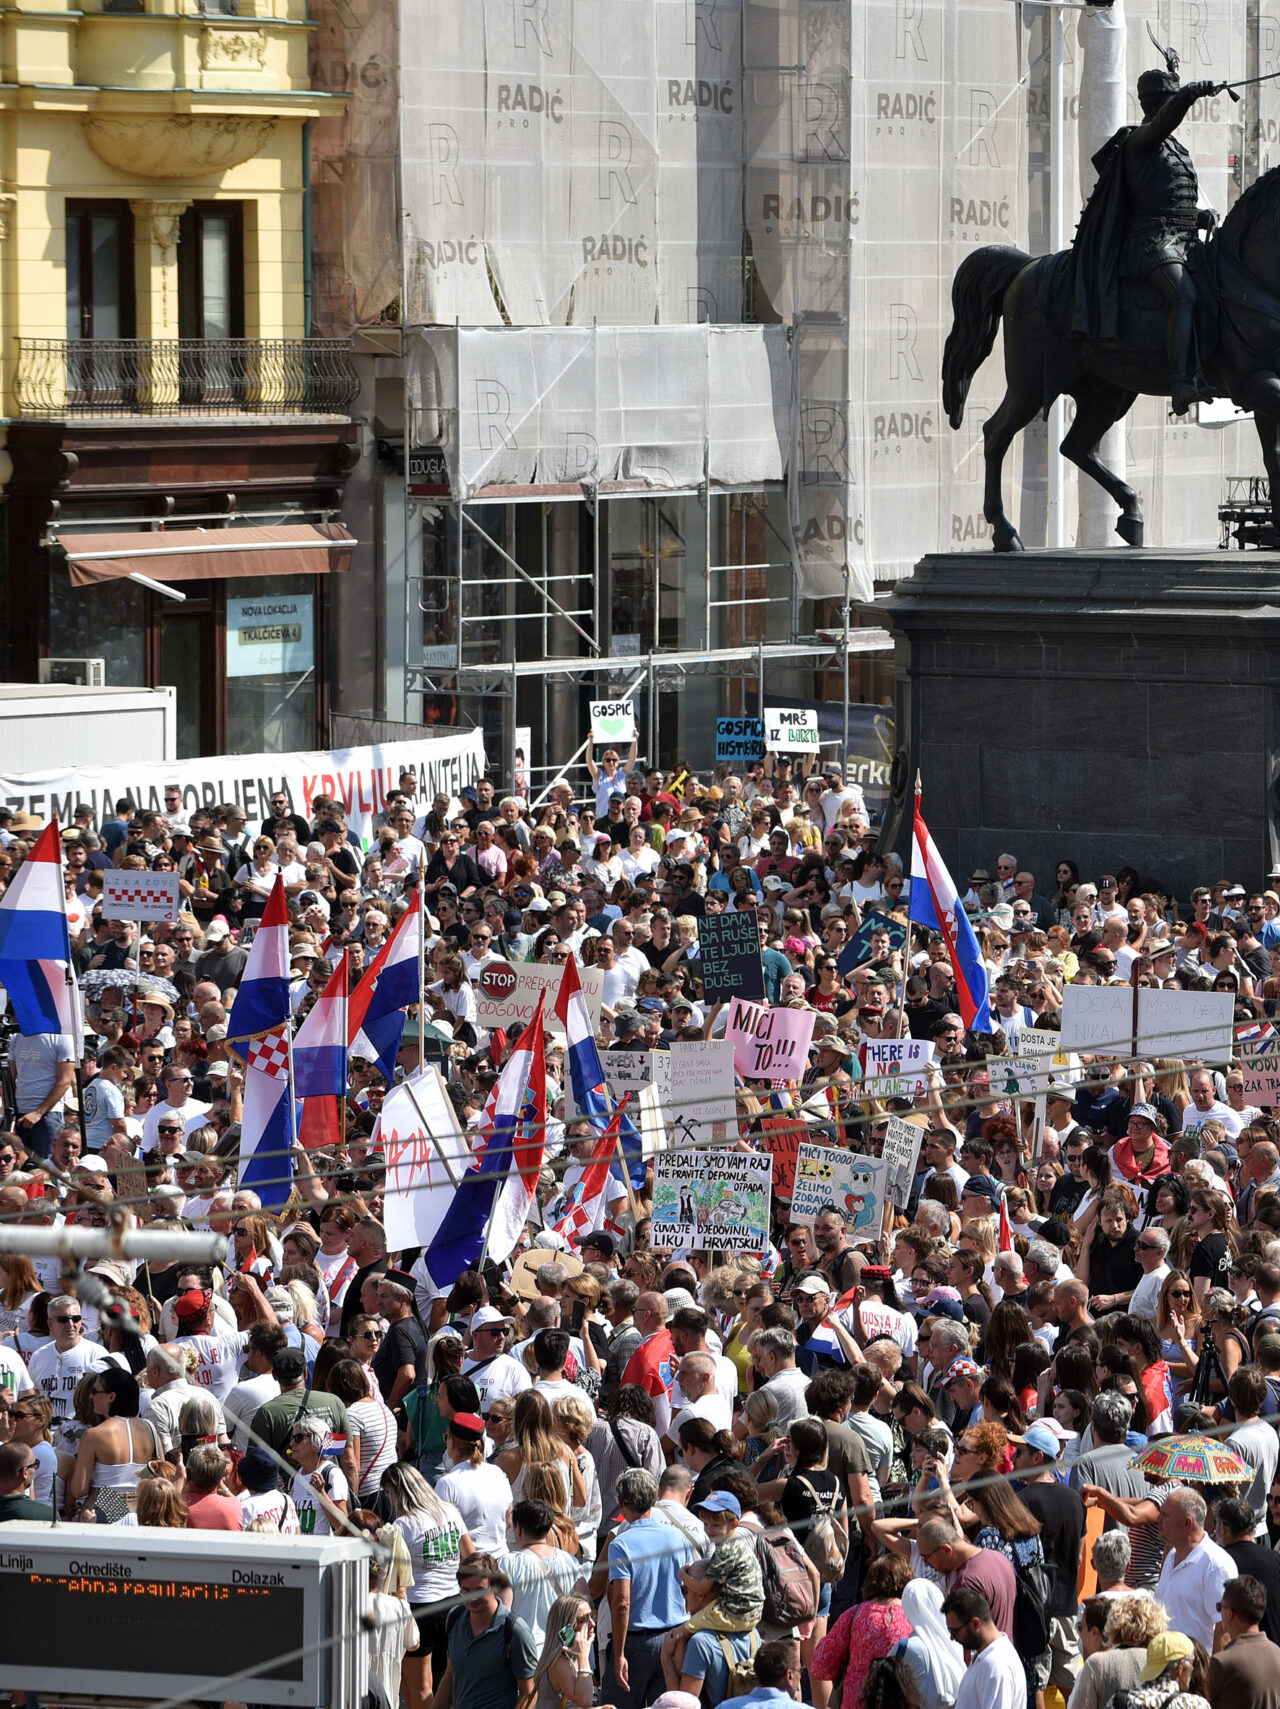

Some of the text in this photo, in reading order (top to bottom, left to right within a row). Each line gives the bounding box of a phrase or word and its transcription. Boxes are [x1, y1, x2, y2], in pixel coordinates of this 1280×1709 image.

[498, 82, 566, 124] RADIĆ
[668, 79, 734, 115] RADIĆ
[877, 89, 937, 124] RADIĆ
[761, 191, 860, 226] RADIĆ
[950, 195, 1010, 229] RADIĆ
[582, 234, 649, 268] RADIĆ
[873, 410, 934, 444] RADIĆ
[800, 514, 865, 546] ADIĆ
[242, 603, 299, 617] NOVA LOKACIJA
[291, 631, 298, 640] 4
[593, 701, 633, 718] GOSPIĆ
[780, 710, 809, 726] MRŠ
[771, 729, 819, 744] IZ LIKE
[145, 878, 175, 887] ZOVE
[701, 912, 751, 930] NE DAM
[701, 926, 757, 946] DA RUŠE
[702, 941, 761, 960] TE LJUDI
[703, 960, 729, 975] BEZ
[483, 972, 516, 988] STOP
[705, 974, 743, 990] DUŠE!
[1020, 1033, 1057, 1047] DOSTA JE
[866, 1044, 921, 1062] THERE IS
[877, 1060, 901, 1077] NO
[1247, 1058, 1279, 1072] VODU
[871, 1078, 927, 1097] PLANET B
[1244, 1079, 1263, 1093] ZAR
[659, 1153, 771, 1171] PREDALI SMO VAM RAJ
[657, 1168, 670, 1179] NE
[672, 1168, 705, 1180] PRAVITE
[733, 1182, 766, 1196] OTPADA,
[796, 1178, 833, 1196] ŽELIMO
[794, 1191, 834, 1207] ZDRAVO
[653, 1220, 692, 1235] ČUVAJTE
[653, 1232, 764, 1251] LIKU I HRVATSKU!
[862, 1311, 903, 1331] DOSTA JE
[62, 1375, 77, 1391] TO!
[0, 1554, 285, 1586] Linija Odredište Dolazak
